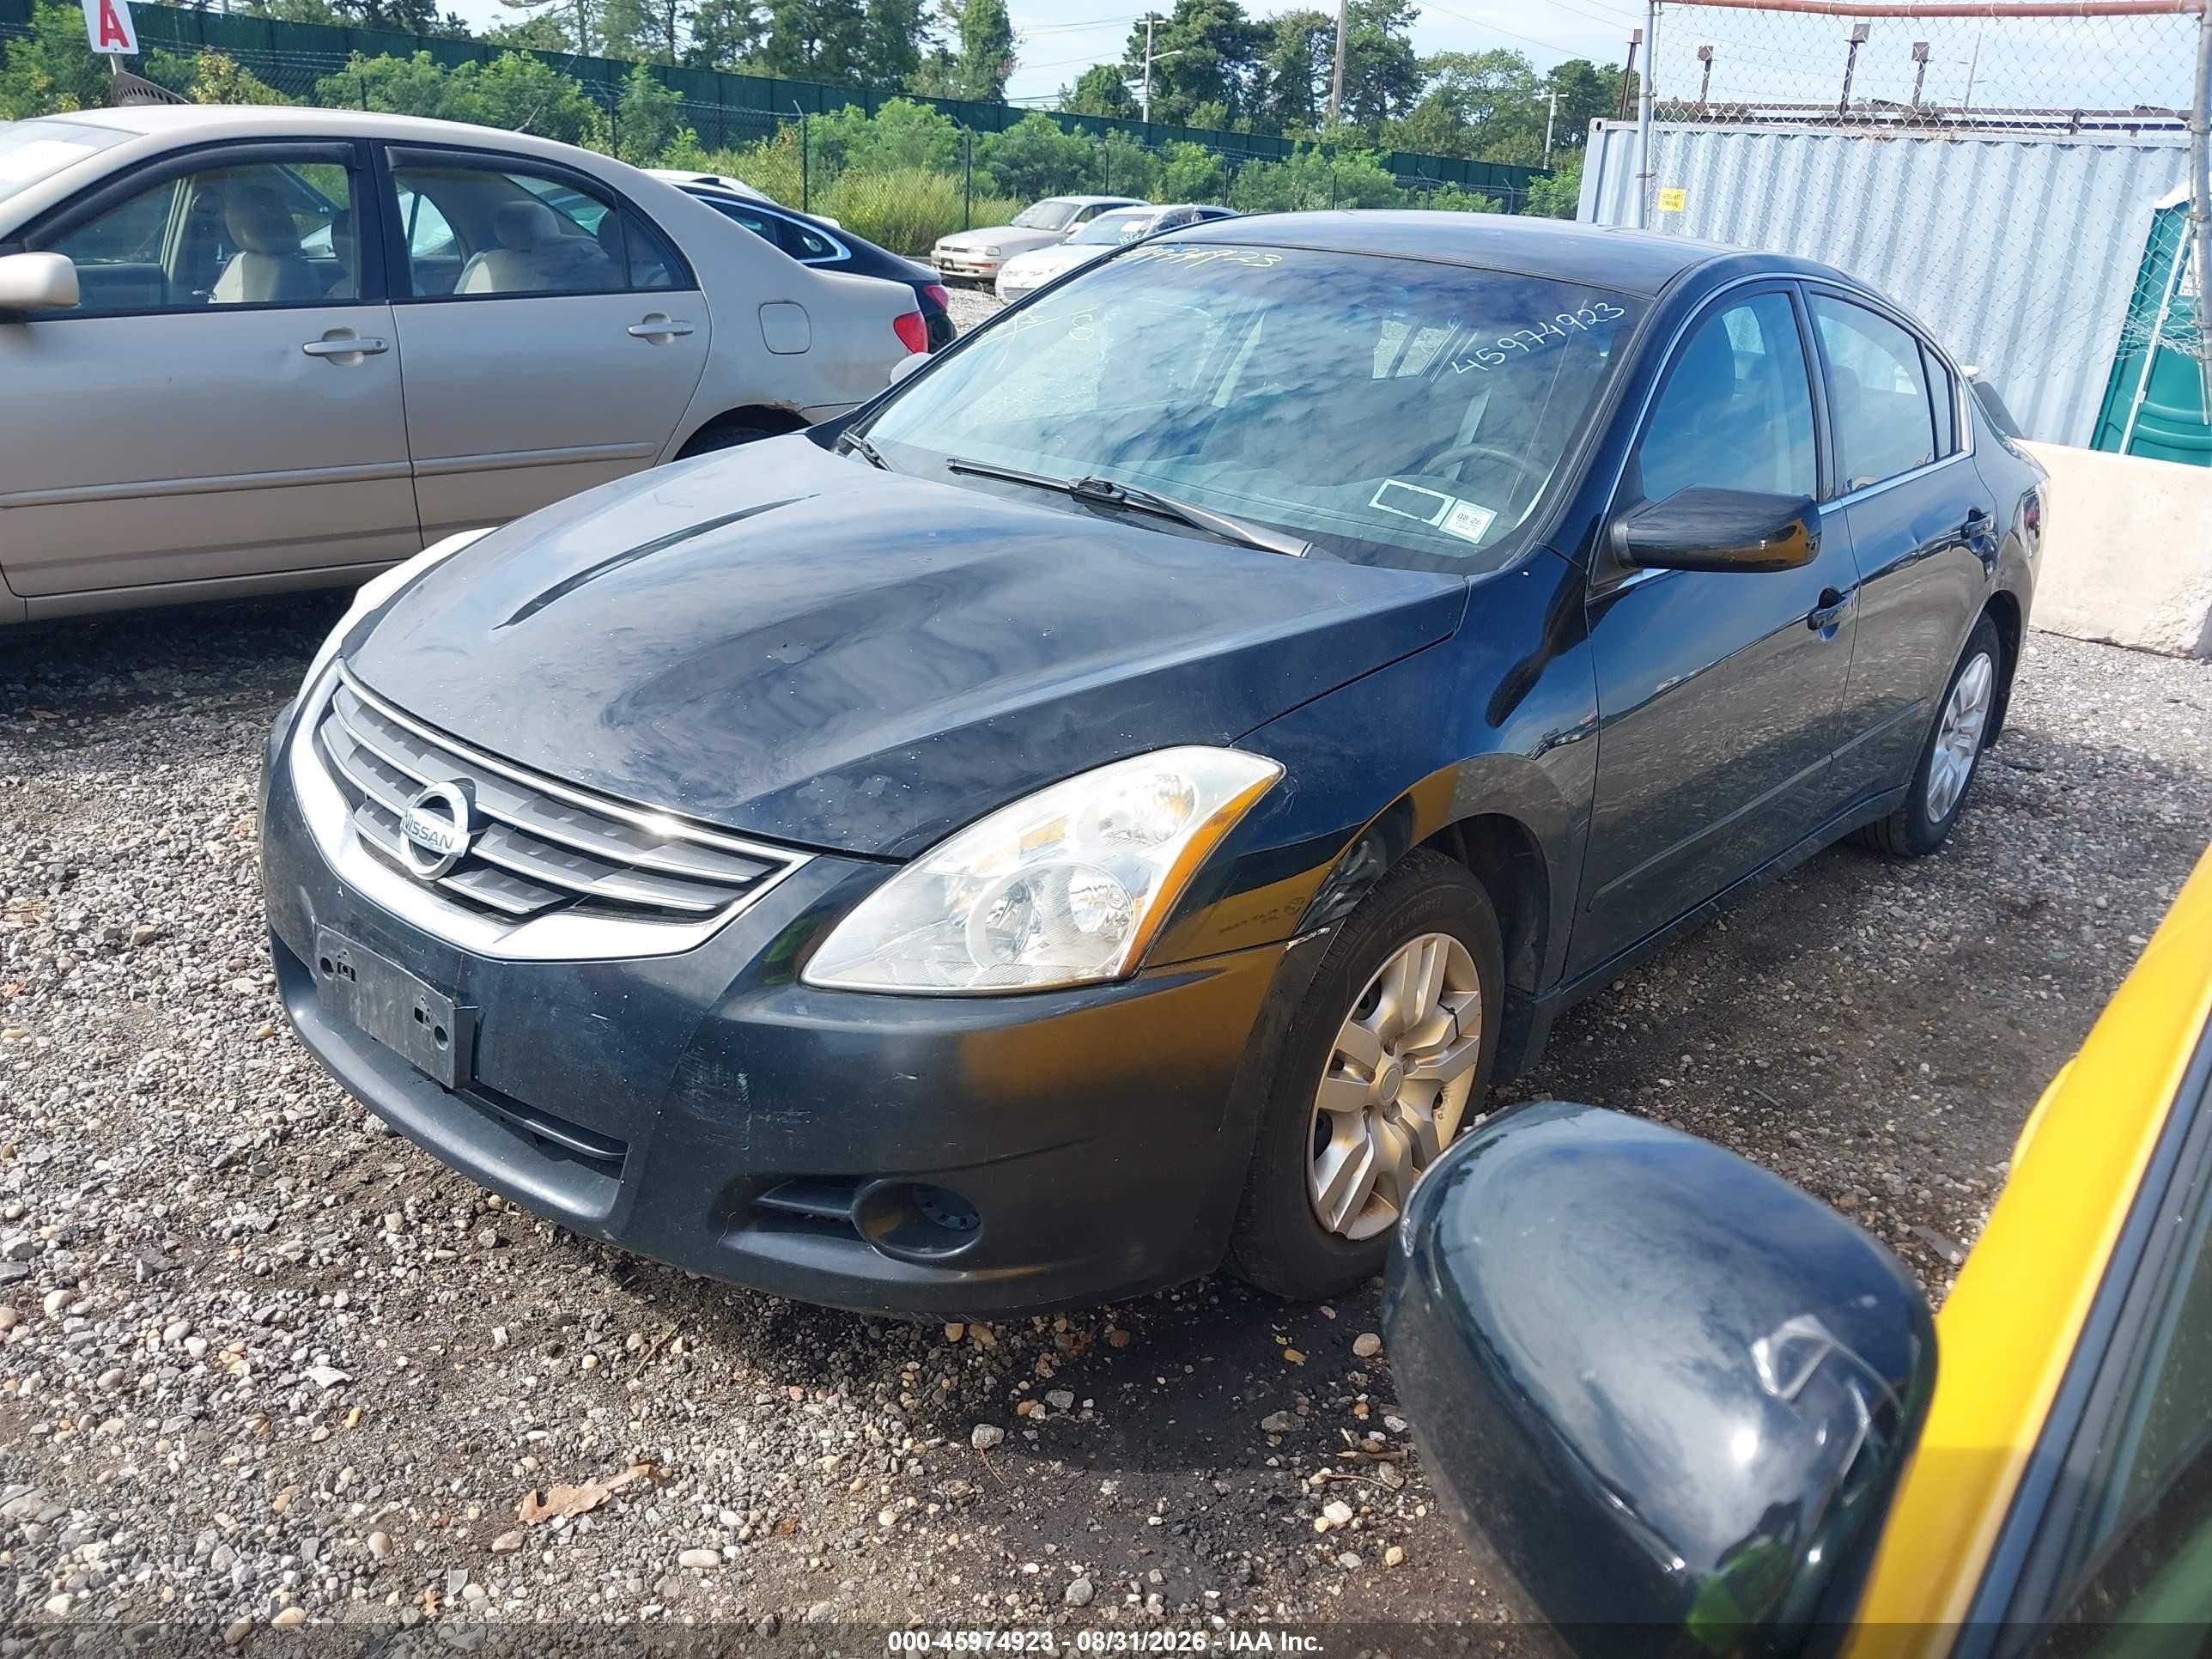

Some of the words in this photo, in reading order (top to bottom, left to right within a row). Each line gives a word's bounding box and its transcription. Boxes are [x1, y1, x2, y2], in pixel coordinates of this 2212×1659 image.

[100, 0, 130, 48] A
[1451, 302, 1626, 374] 45974923
[400, 809, 454, 850] NISSAN
